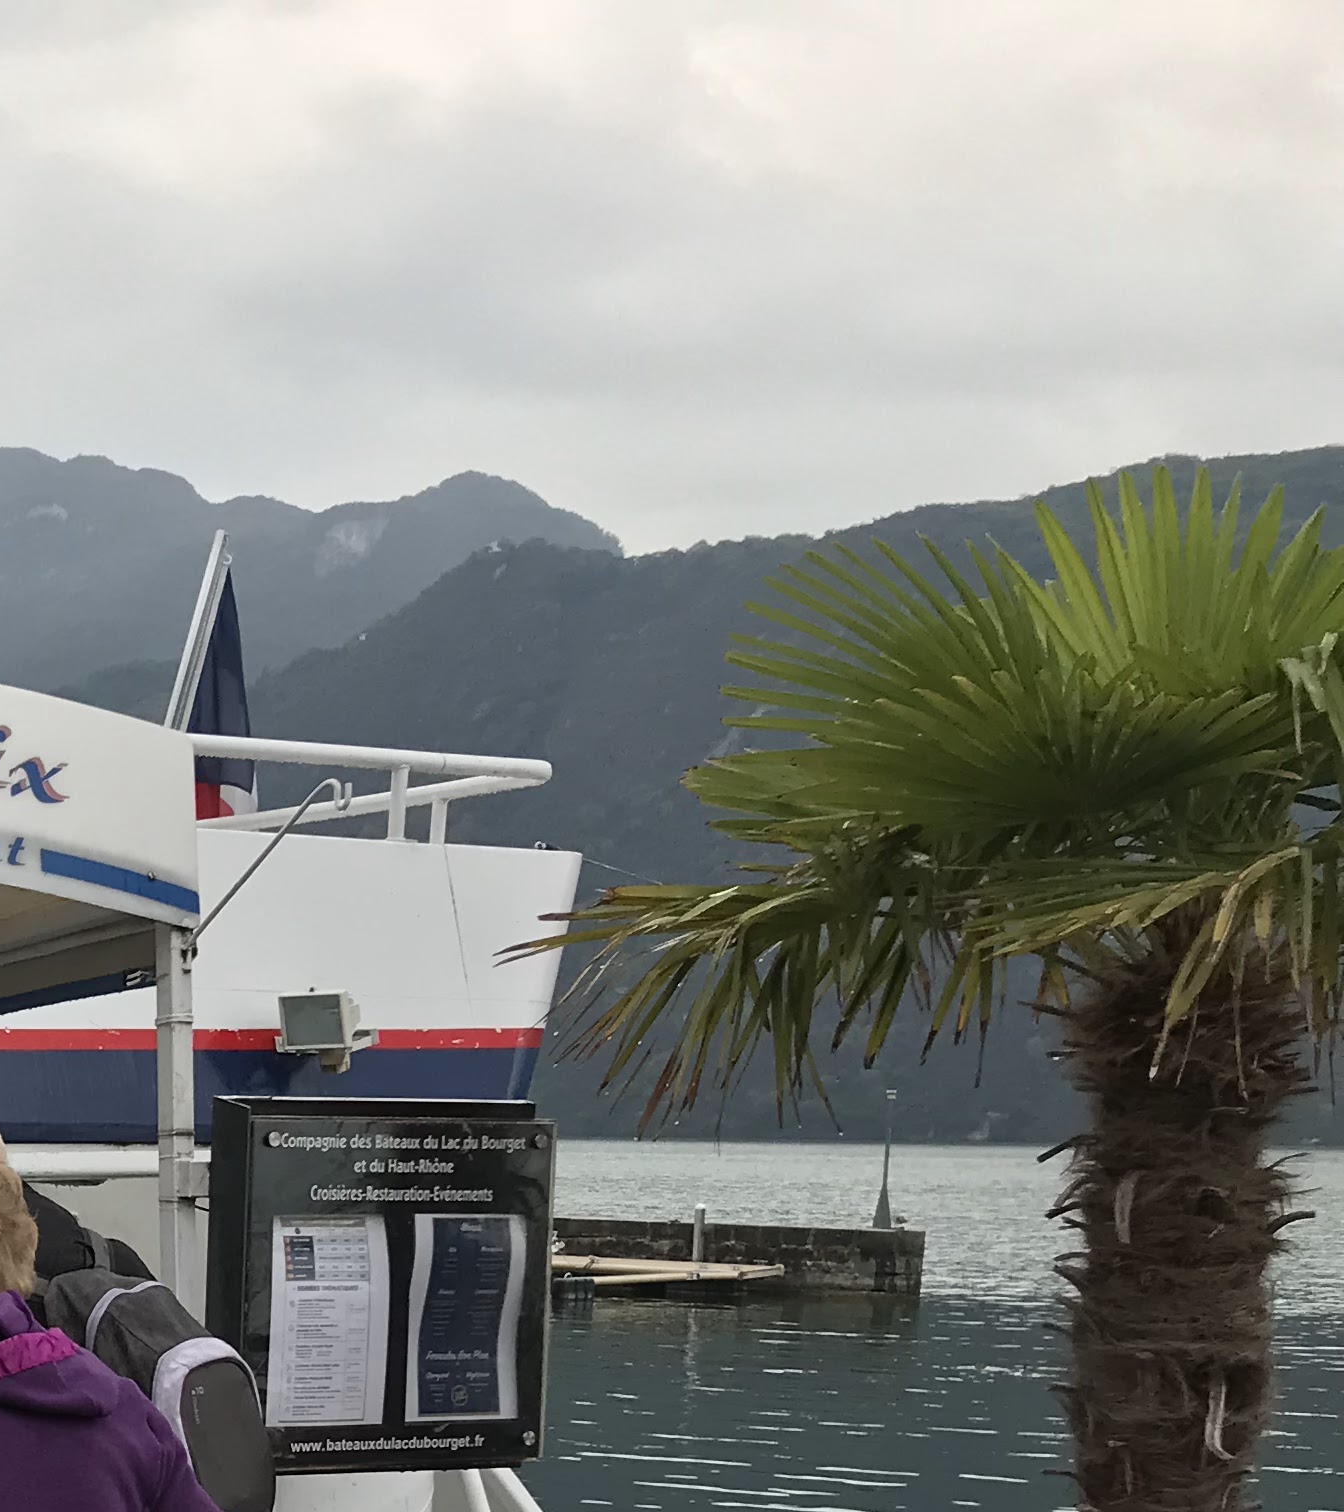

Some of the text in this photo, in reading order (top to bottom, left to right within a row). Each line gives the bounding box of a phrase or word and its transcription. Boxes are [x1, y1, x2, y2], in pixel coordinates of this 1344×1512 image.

[281, 1132, 526, 1153] Compagnie des Bateaux du Lac du Bourget
[353, 1157, 455, 1174] et du Haut-Rhône
[290, 1433, 486, 1453] www.bateauxdulacdubourget.fr
